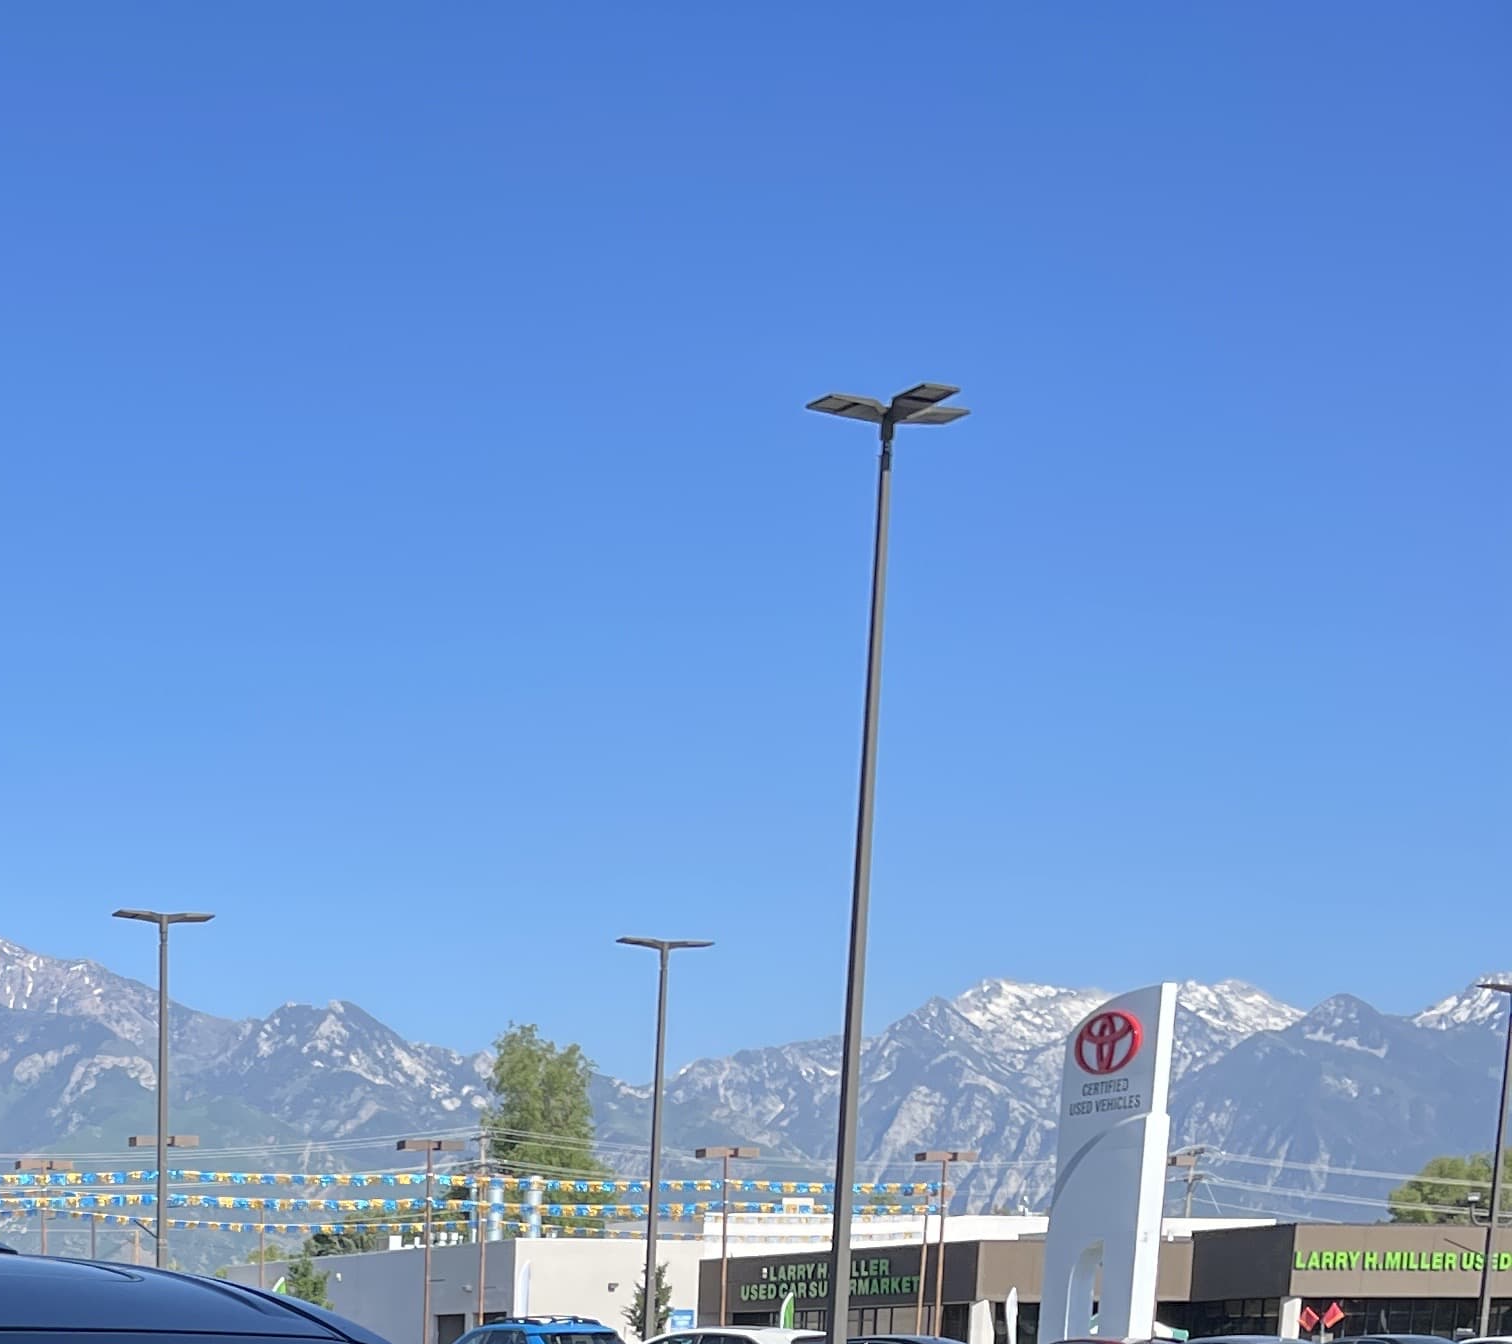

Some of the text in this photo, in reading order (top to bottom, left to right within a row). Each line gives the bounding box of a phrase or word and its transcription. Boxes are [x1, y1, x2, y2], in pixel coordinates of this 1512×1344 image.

[1082, 1079, 1129, 1096] CERTIFIED
[1069, 1095, 1141, 1116] USED VEHICLES
[769, 1263, 815, 1281] LARRY
[851, 1259, 889, 1277] LLER
[1294, 1251, 1360, 1270] LARRY
[741, 1283, 777, 1300] USED
